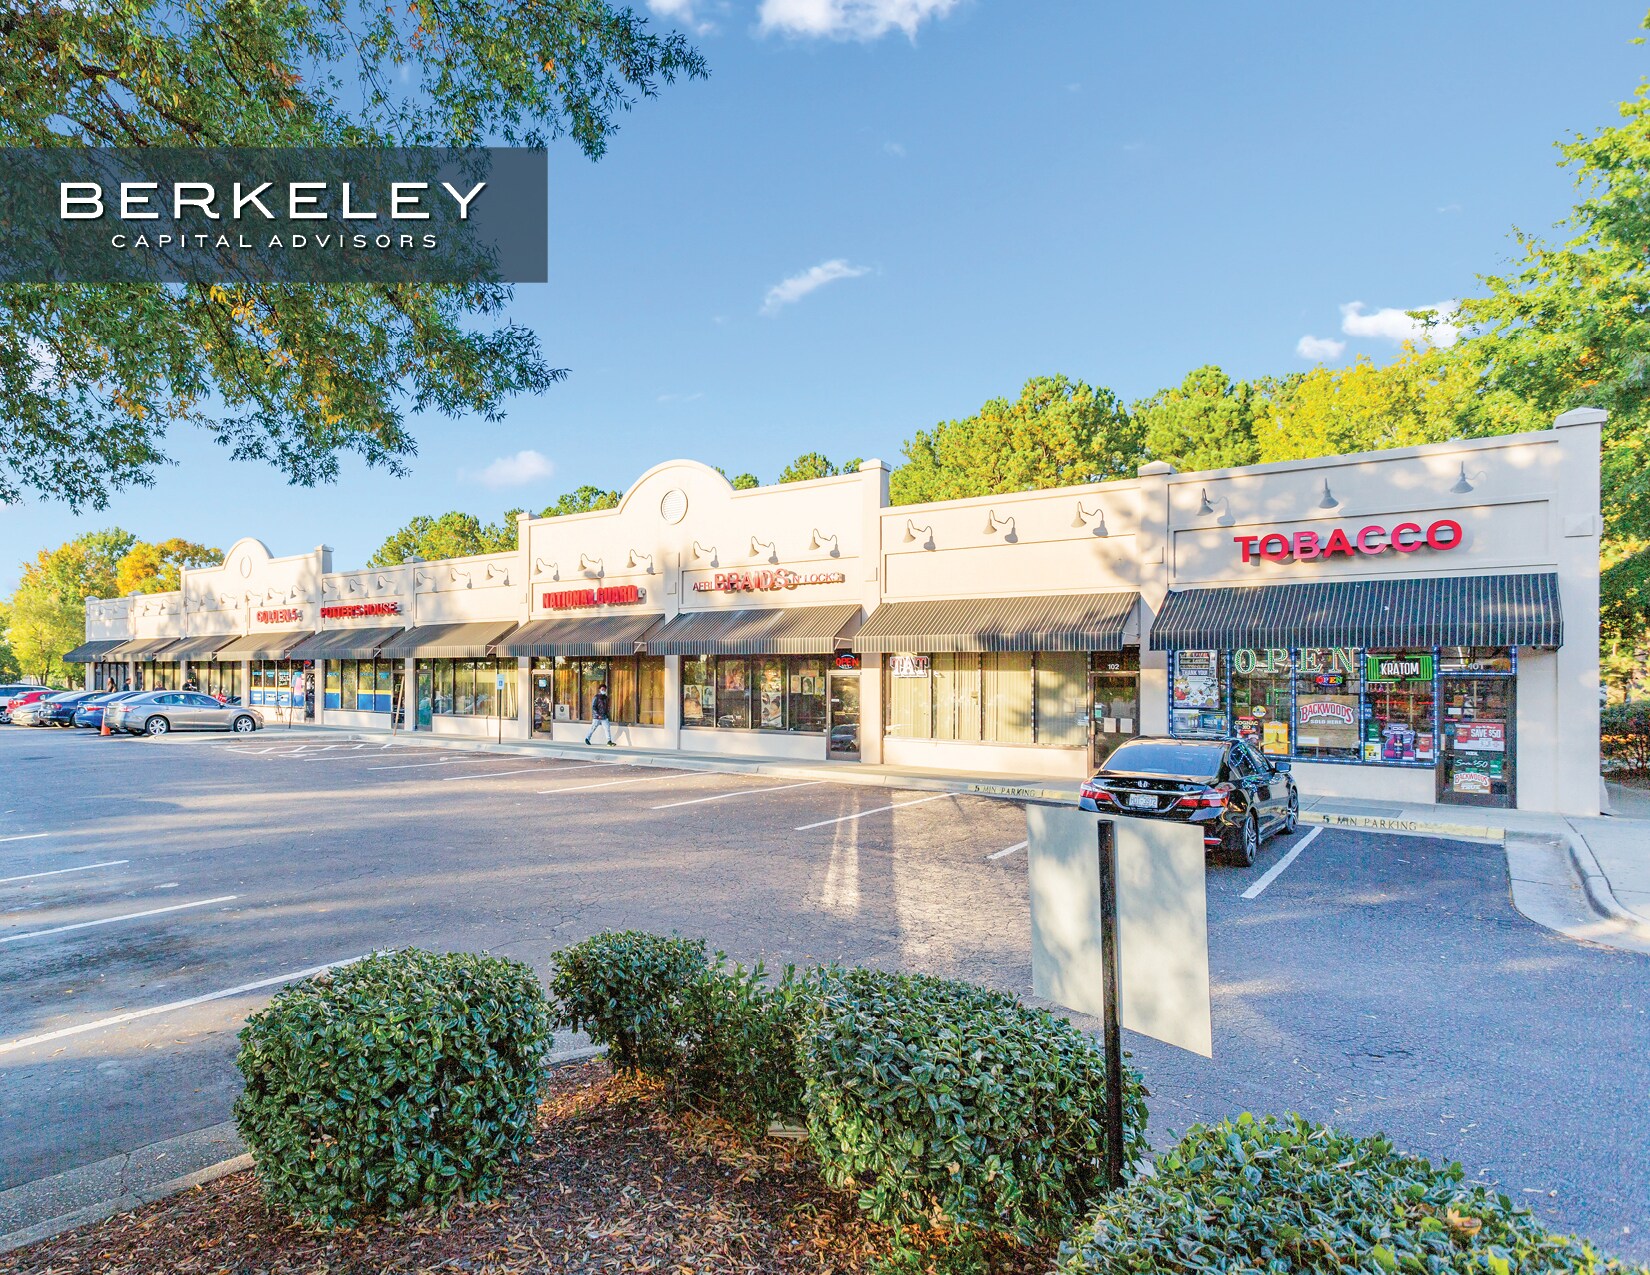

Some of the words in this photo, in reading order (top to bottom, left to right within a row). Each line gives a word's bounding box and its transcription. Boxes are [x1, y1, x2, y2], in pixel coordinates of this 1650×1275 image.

[1233, 519, 1463, 563] TOBACCO
[714, 568, 790, 592] BRAIDS
[542, 588, 598, 609] NATIONAL
[597, 584, 638, 605] GUARD
[256, 608, 291, 625] GOLDEN
[363, 601, 398, 617] HOUSE
[835, 656, 860, 668] OPEN
[1234, 647, 1361, 674] OPEN
[1380, 662, 1420, 676] KRATOM
[1315, 675, 1343, 684] OPEN
[1300, 702, 1354, 725] BACKWOODS
[1470, 728, 1488, 738] SAVE
[1488, 729, 1502, 739] $50
[1454, 773, 1490, 786] BACKWOODS
[1001, 787, 1036, 798] PARKING
[1322, 815, 1330, 824] 5
[1337, 816, 1357, 827] MIN
[1364, 818, 1418, 831] PARKING
